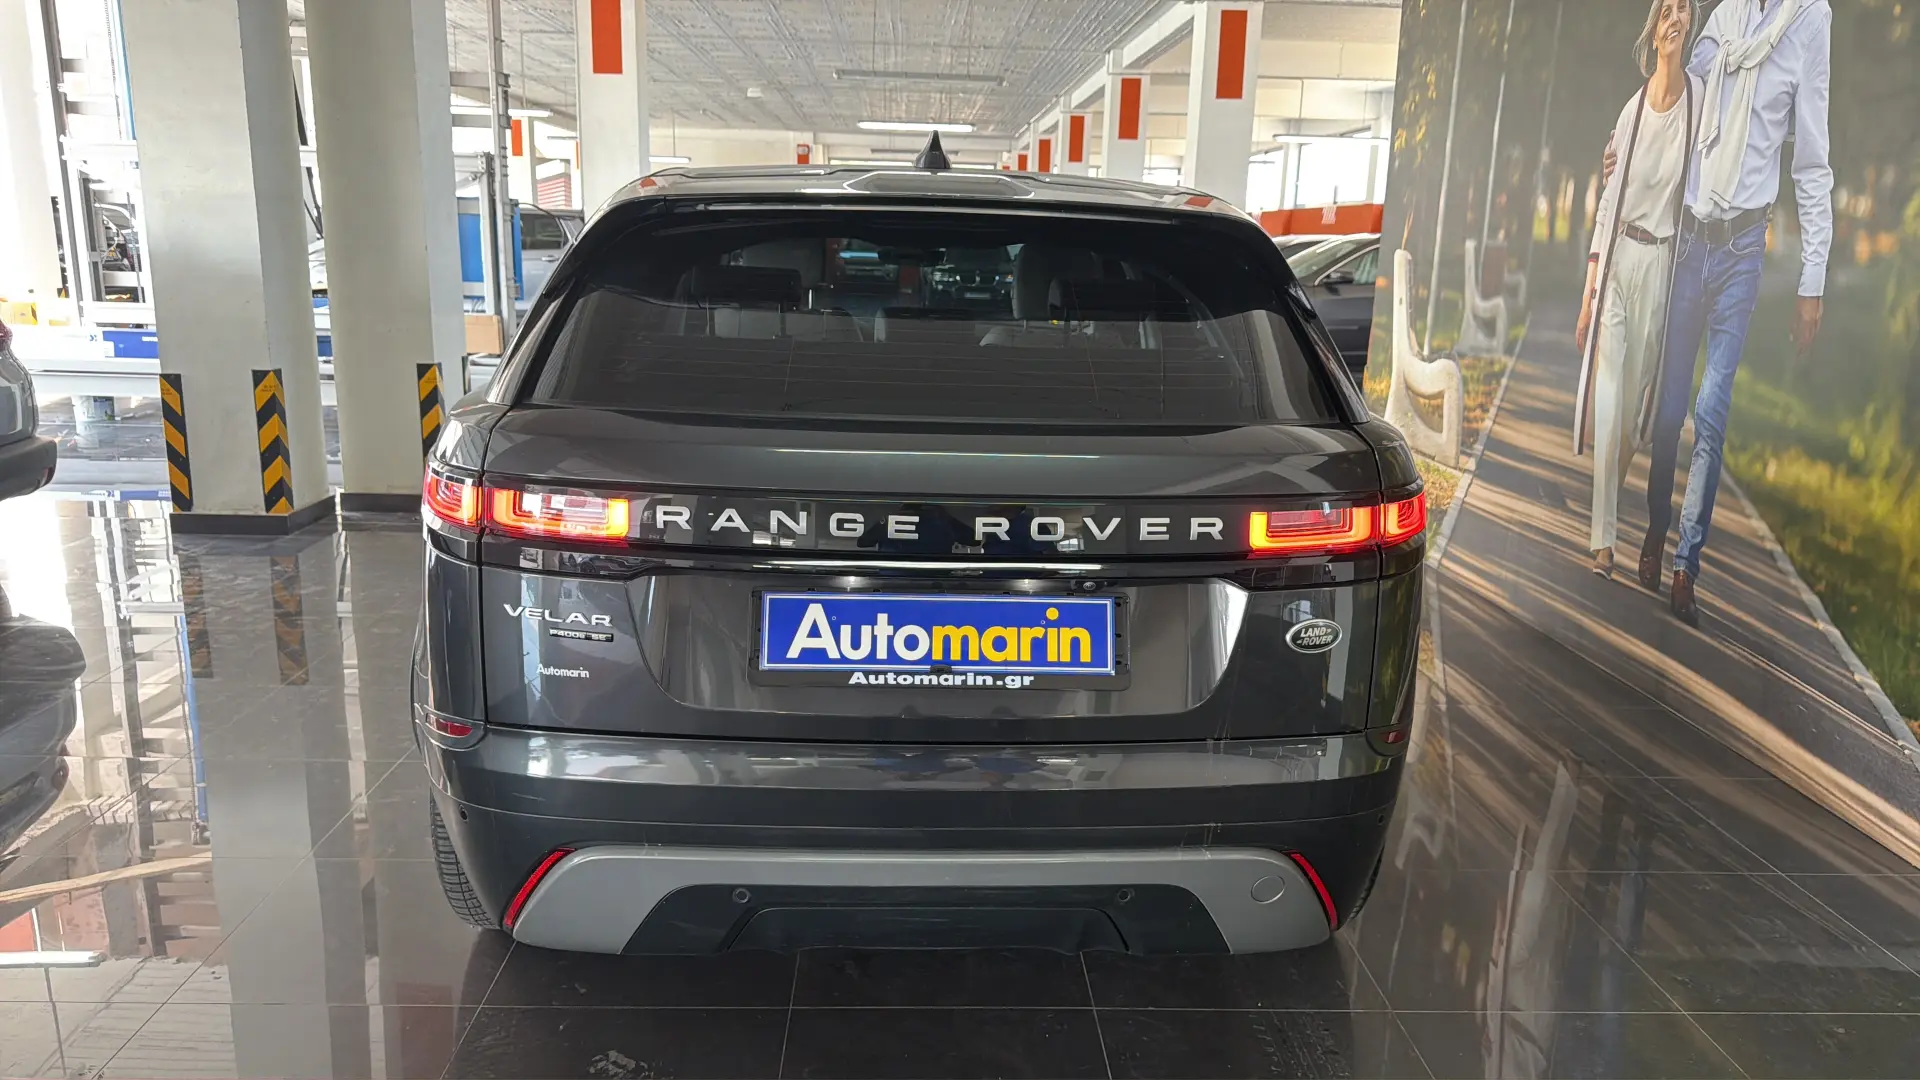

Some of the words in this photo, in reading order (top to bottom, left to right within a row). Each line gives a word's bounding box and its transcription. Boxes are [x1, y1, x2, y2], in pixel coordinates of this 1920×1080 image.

[656, 505, 920, 539] RANGE
[974, 516, 1224, 541] ROVER
[503, 603, 613, 627] VELAR
[786, 603, 1092, 662] Automarin
[1300, 626, 1327, 637] LAND
[1302, 635, 1333, 646] ROVER
[536, 663, 590, 678] Automarin
[848, 671, 1034, 689] Automarin.gr
